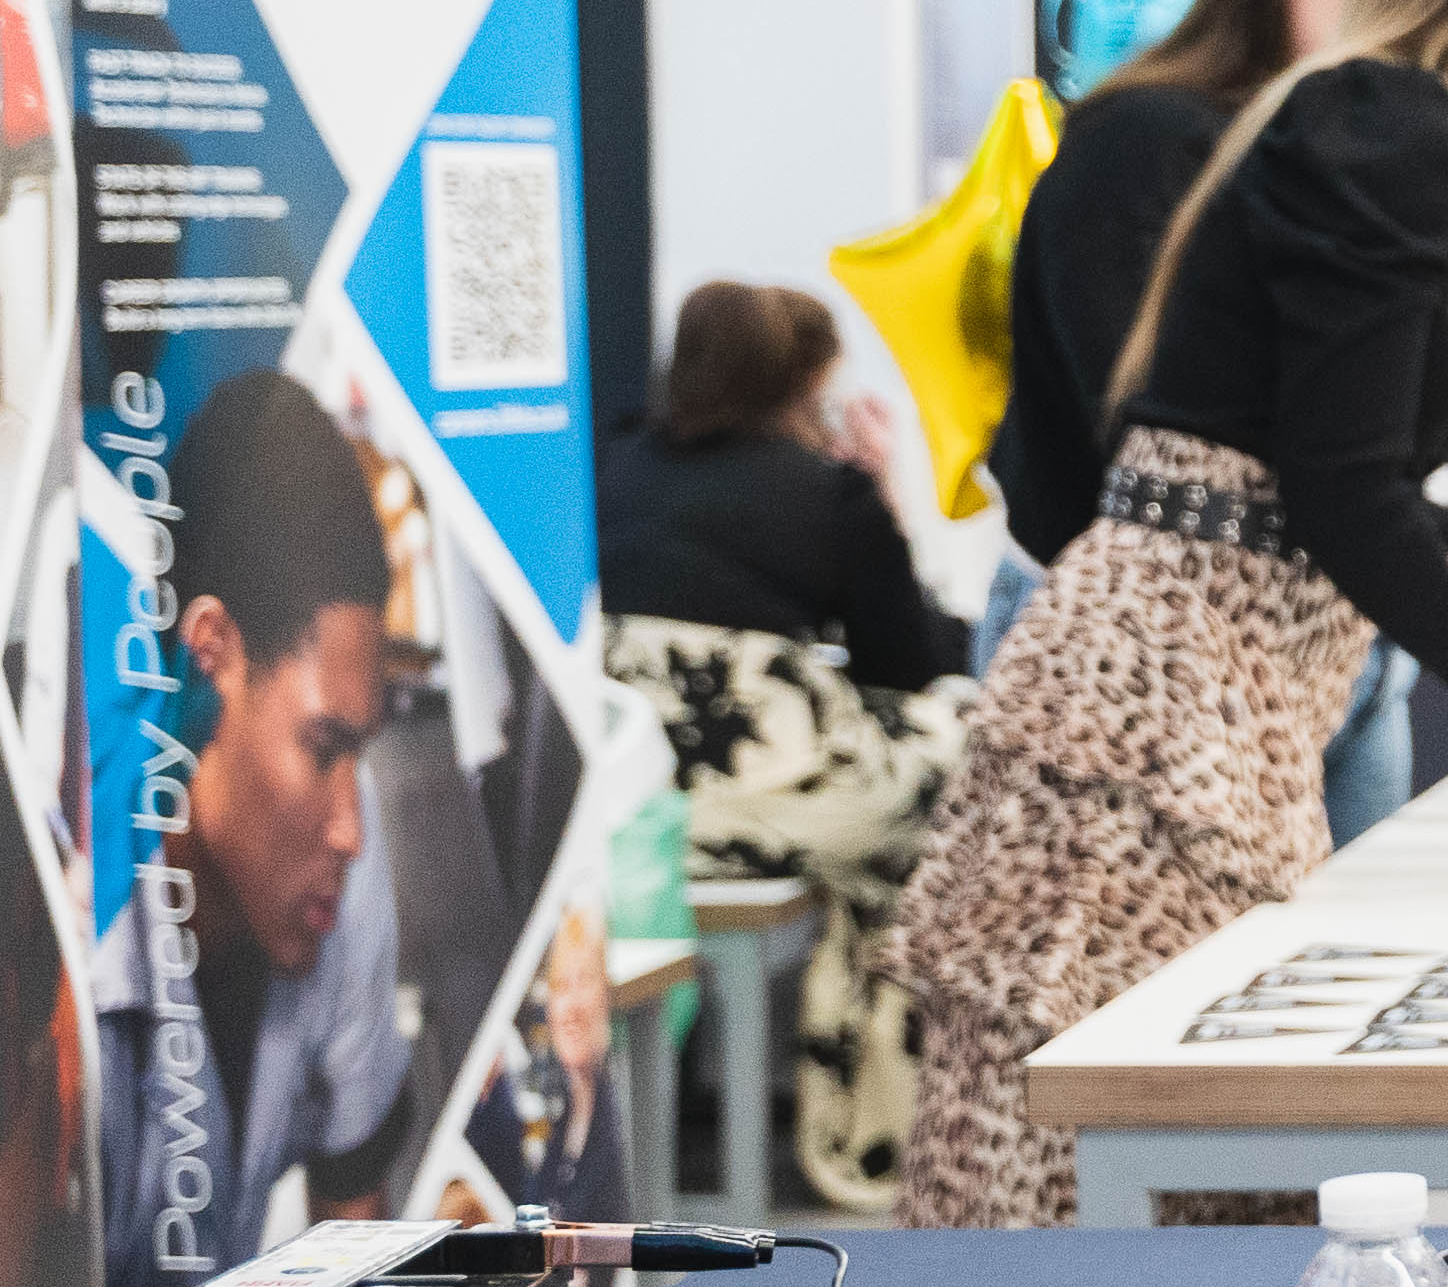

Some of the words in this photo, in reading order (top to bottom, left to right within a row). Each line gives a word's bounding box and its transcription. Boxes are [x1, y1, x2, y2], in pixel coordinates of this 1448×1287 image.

[101, 370, 184, 692] People
[131, 719, 198, 834] by
[136, 863, 215, 1271] Powered
